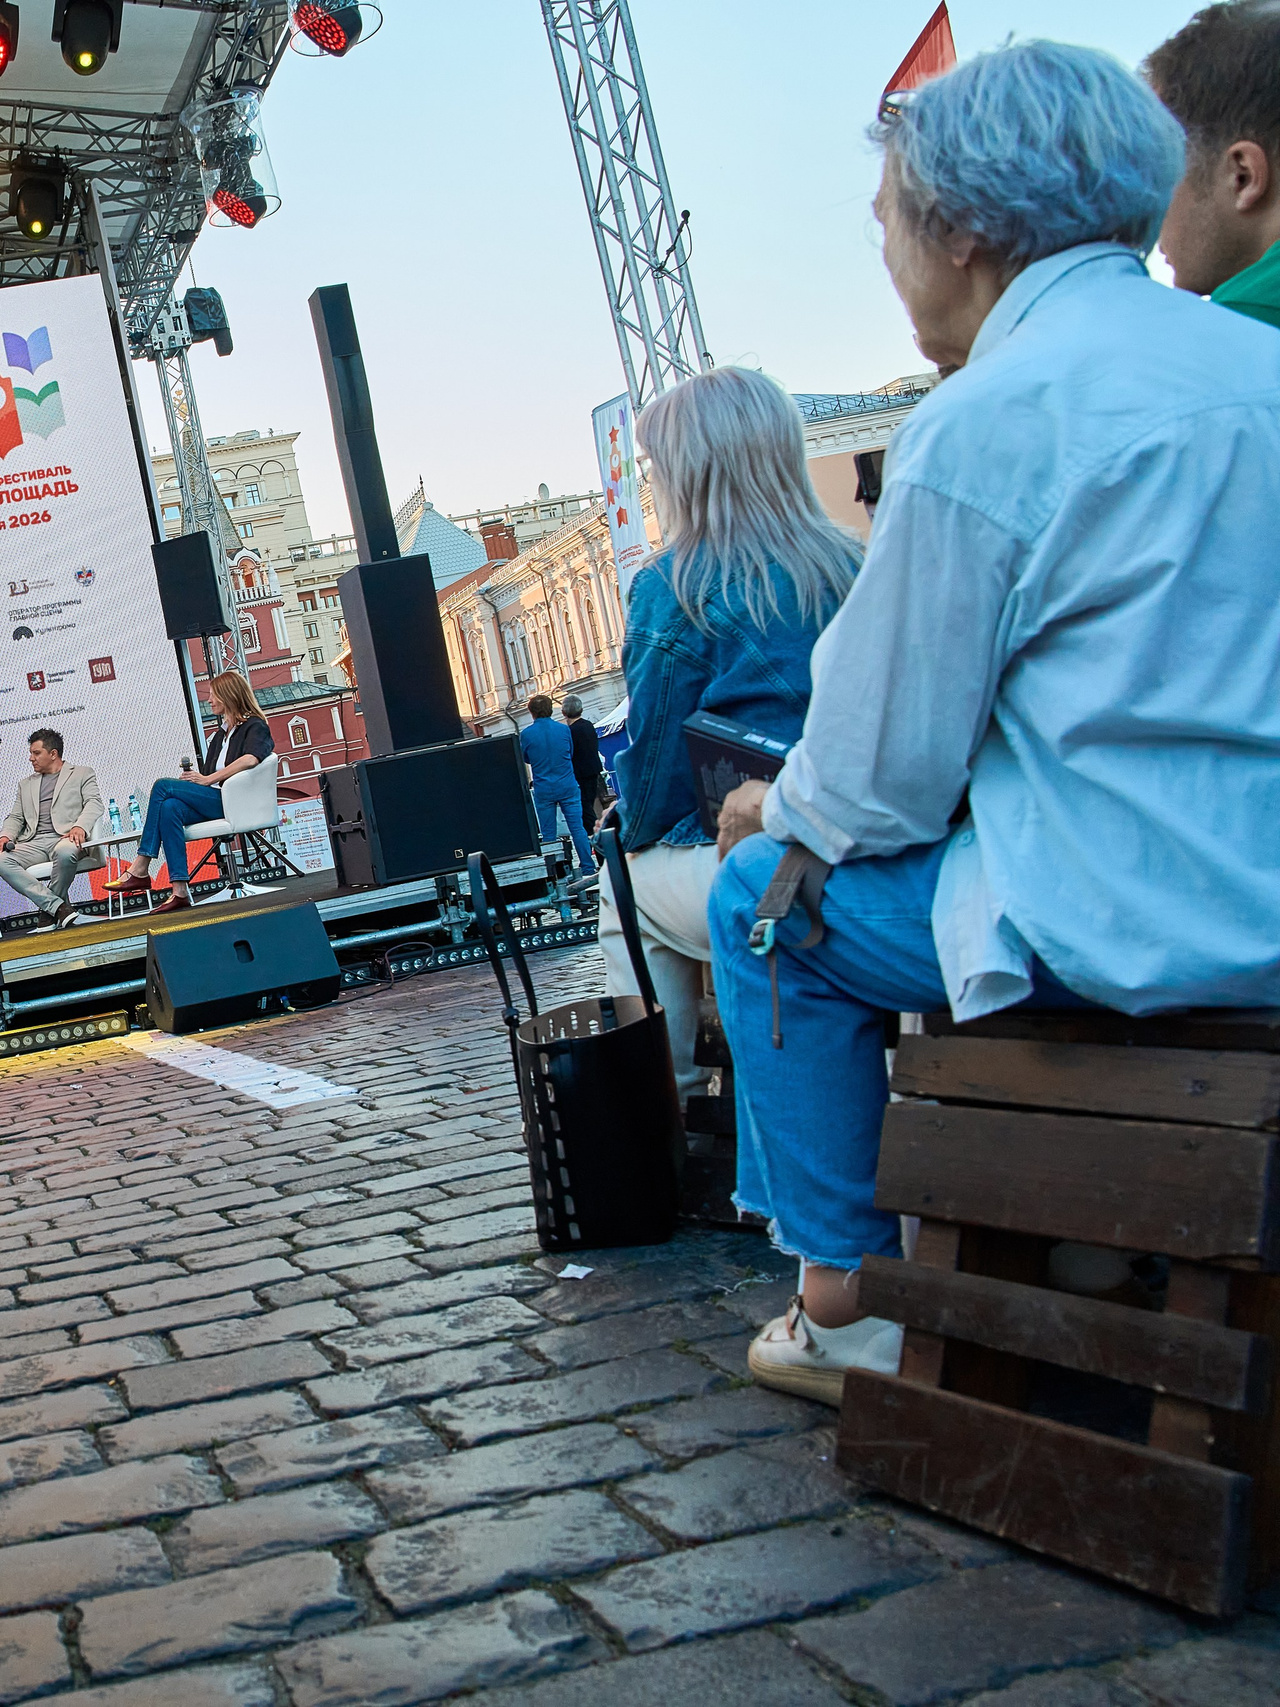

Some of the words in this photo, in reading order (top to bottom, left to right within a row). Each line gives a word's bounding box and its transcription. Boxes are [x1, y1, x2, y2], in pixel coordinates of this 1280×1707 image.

[8, 510, 52, 530] 2026
[41, 599, 82, 611] ПРОГРАММЫ
[41, 608, 63, 617] СЦЕНЫ
[31, 712, 47, 720] СЕТЬ
[48, 705, 86, 717] ФЕСТИВАЛЯ
